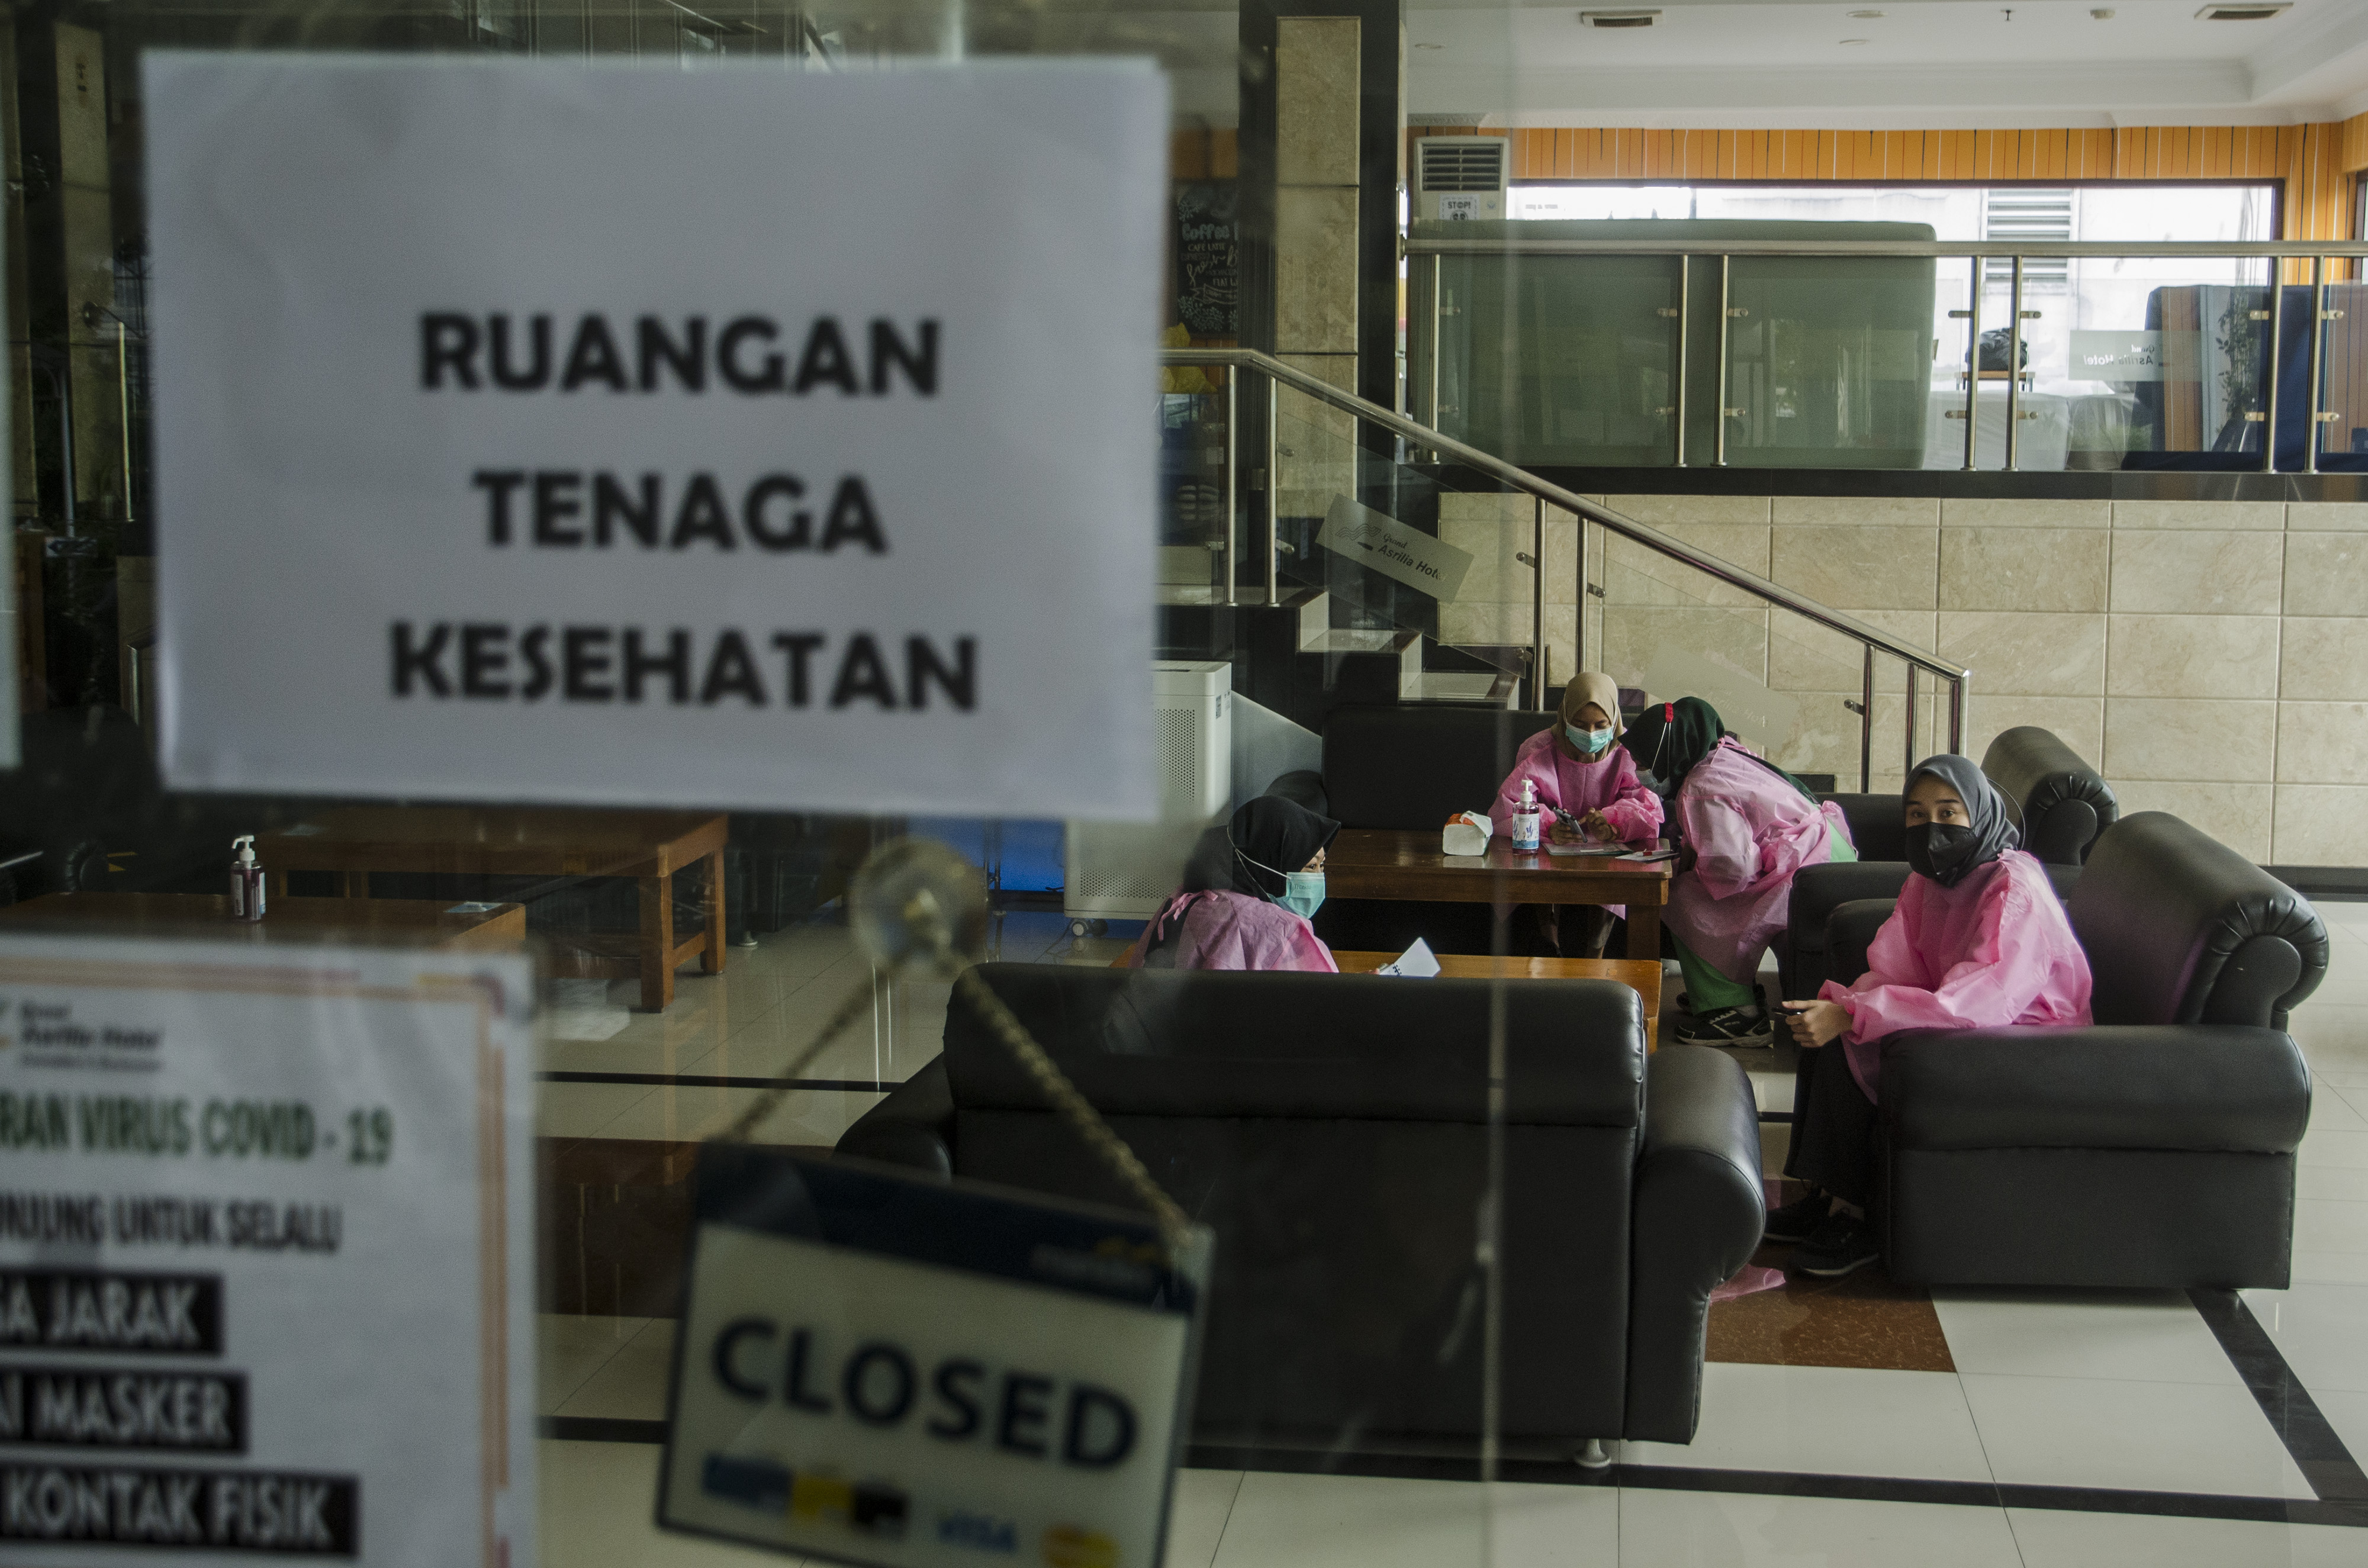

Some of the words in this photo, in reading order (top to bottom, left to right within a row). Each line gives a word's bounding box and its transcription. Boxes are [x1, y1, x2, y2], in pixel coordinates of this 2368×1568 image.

[419, 312, 942, 398] RUANGAN
[471, 470, 889, 556] TENAGA
[1384, 533, 1408, 549] Grand
[1378, 545, 1414, 566] Asrilia
[390, 620, 979, 714] KESEHATAN
[78, 1094, 191, 1158] VIRUS
[201, 1098, 316, 1163] COVID
[346, 1106, 395, 1167] 19
[115, 1195, 217, 1251] UNTUK
[225, 1199, 343, 1257] SELALU
[50, 1277, 200, 1345] JARAK
[37, 1376, 230, 1443] MASKER
[714, 1315, 1138, 1470] CLOSED
[7, 1469, 202, 1542] KONTAK
[214, 1477, 333, 1548] FISIK
